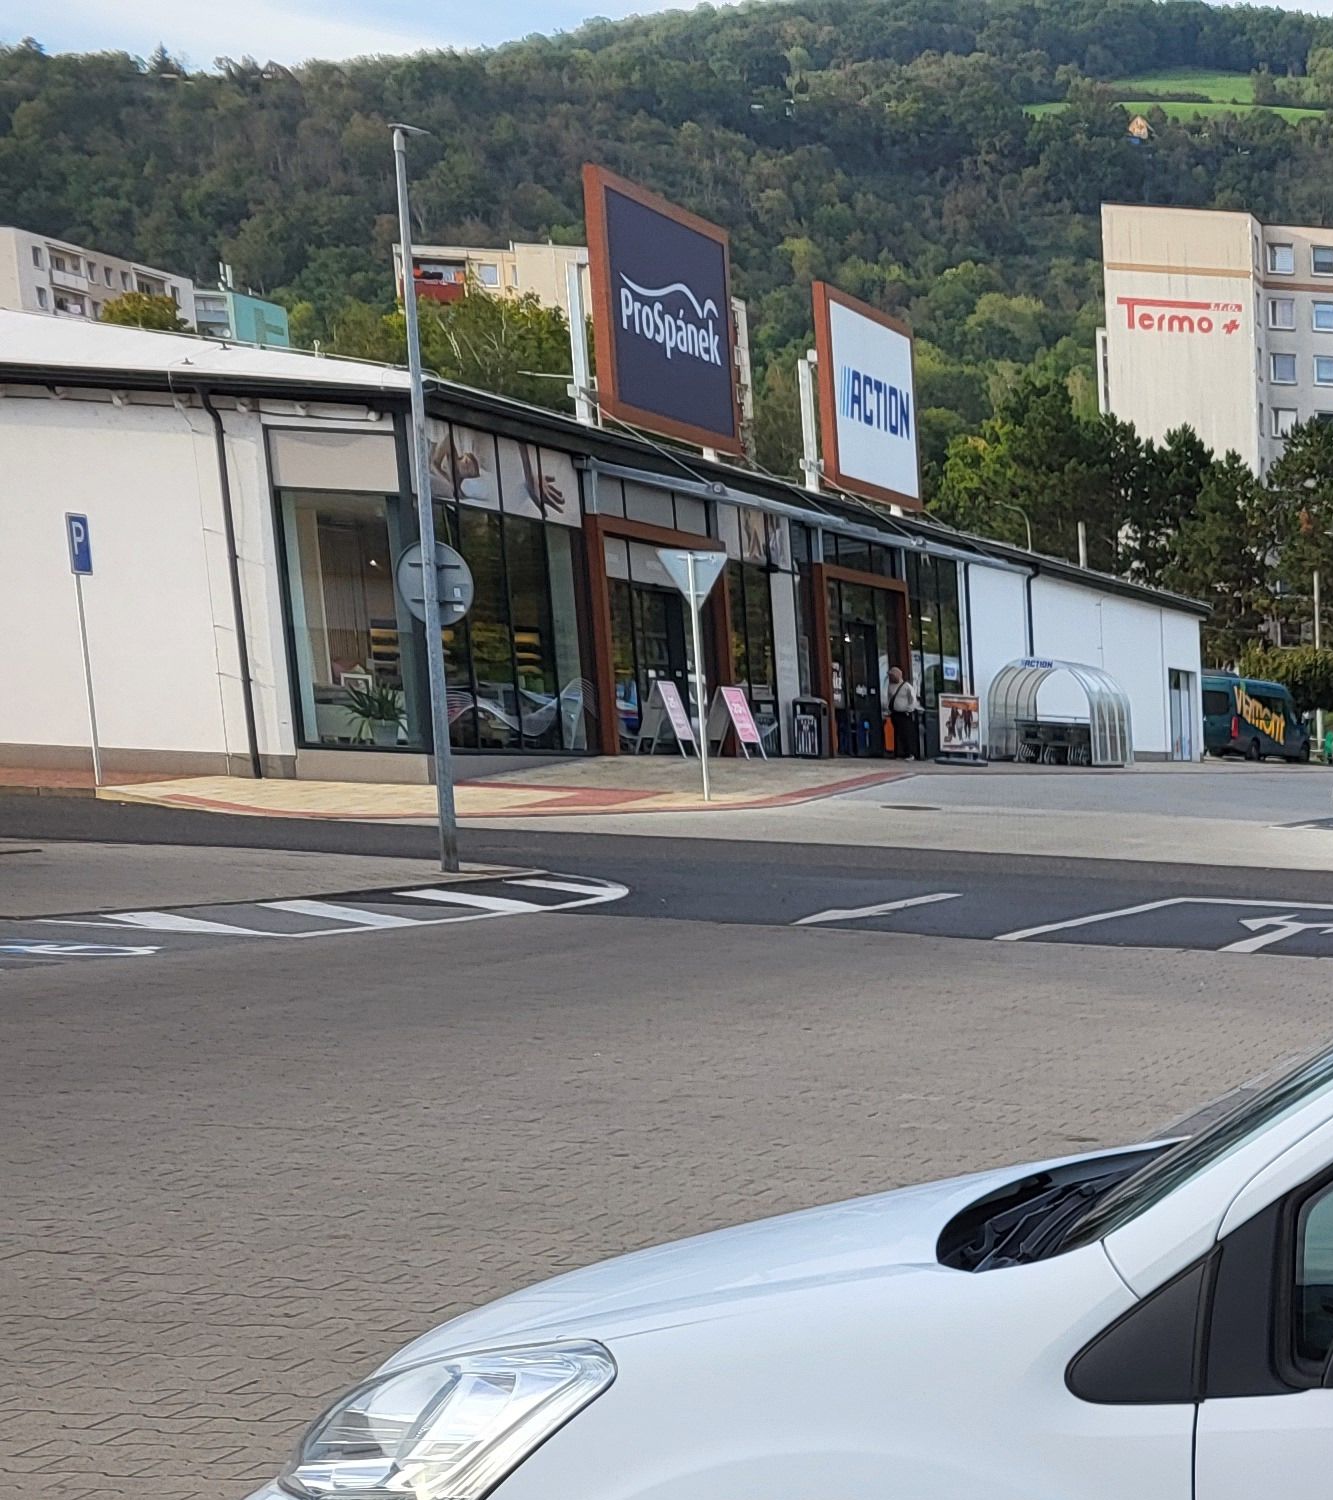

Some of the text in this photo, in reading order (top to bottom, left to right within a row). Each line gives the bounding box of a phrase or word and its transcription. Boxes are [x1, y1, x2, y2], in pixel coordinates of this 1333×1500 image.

[620, 287, 722, 367] ProSpánek
[1117, 297, 1215, 334] Termo
[849, 368, 911, 441] ACTION
[71, 521, 85, 556] P
[1023, 658, 1054, 669] ACTION
